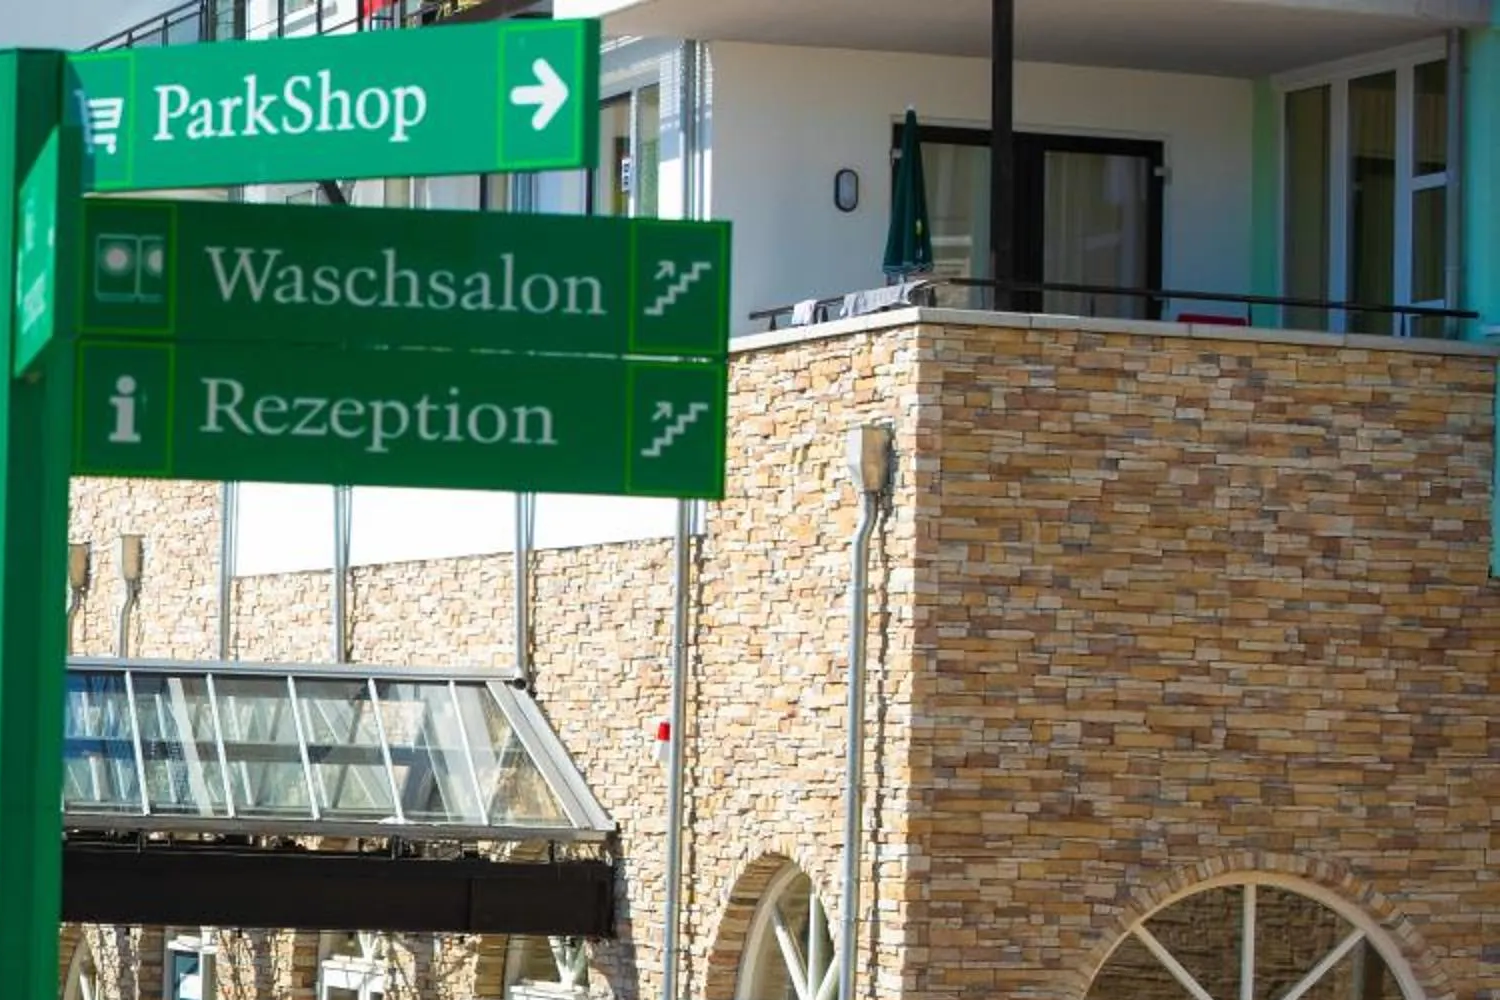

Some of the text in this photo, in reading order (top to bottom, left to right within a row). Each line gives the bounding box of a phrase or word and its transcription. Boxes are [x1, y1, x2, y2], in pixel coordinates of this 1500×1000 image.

[153, 68, 428, 142] ParkShop
[204, 246, 606, 316] Waschsalon
[200, 376, 557, 453] Rezeption
